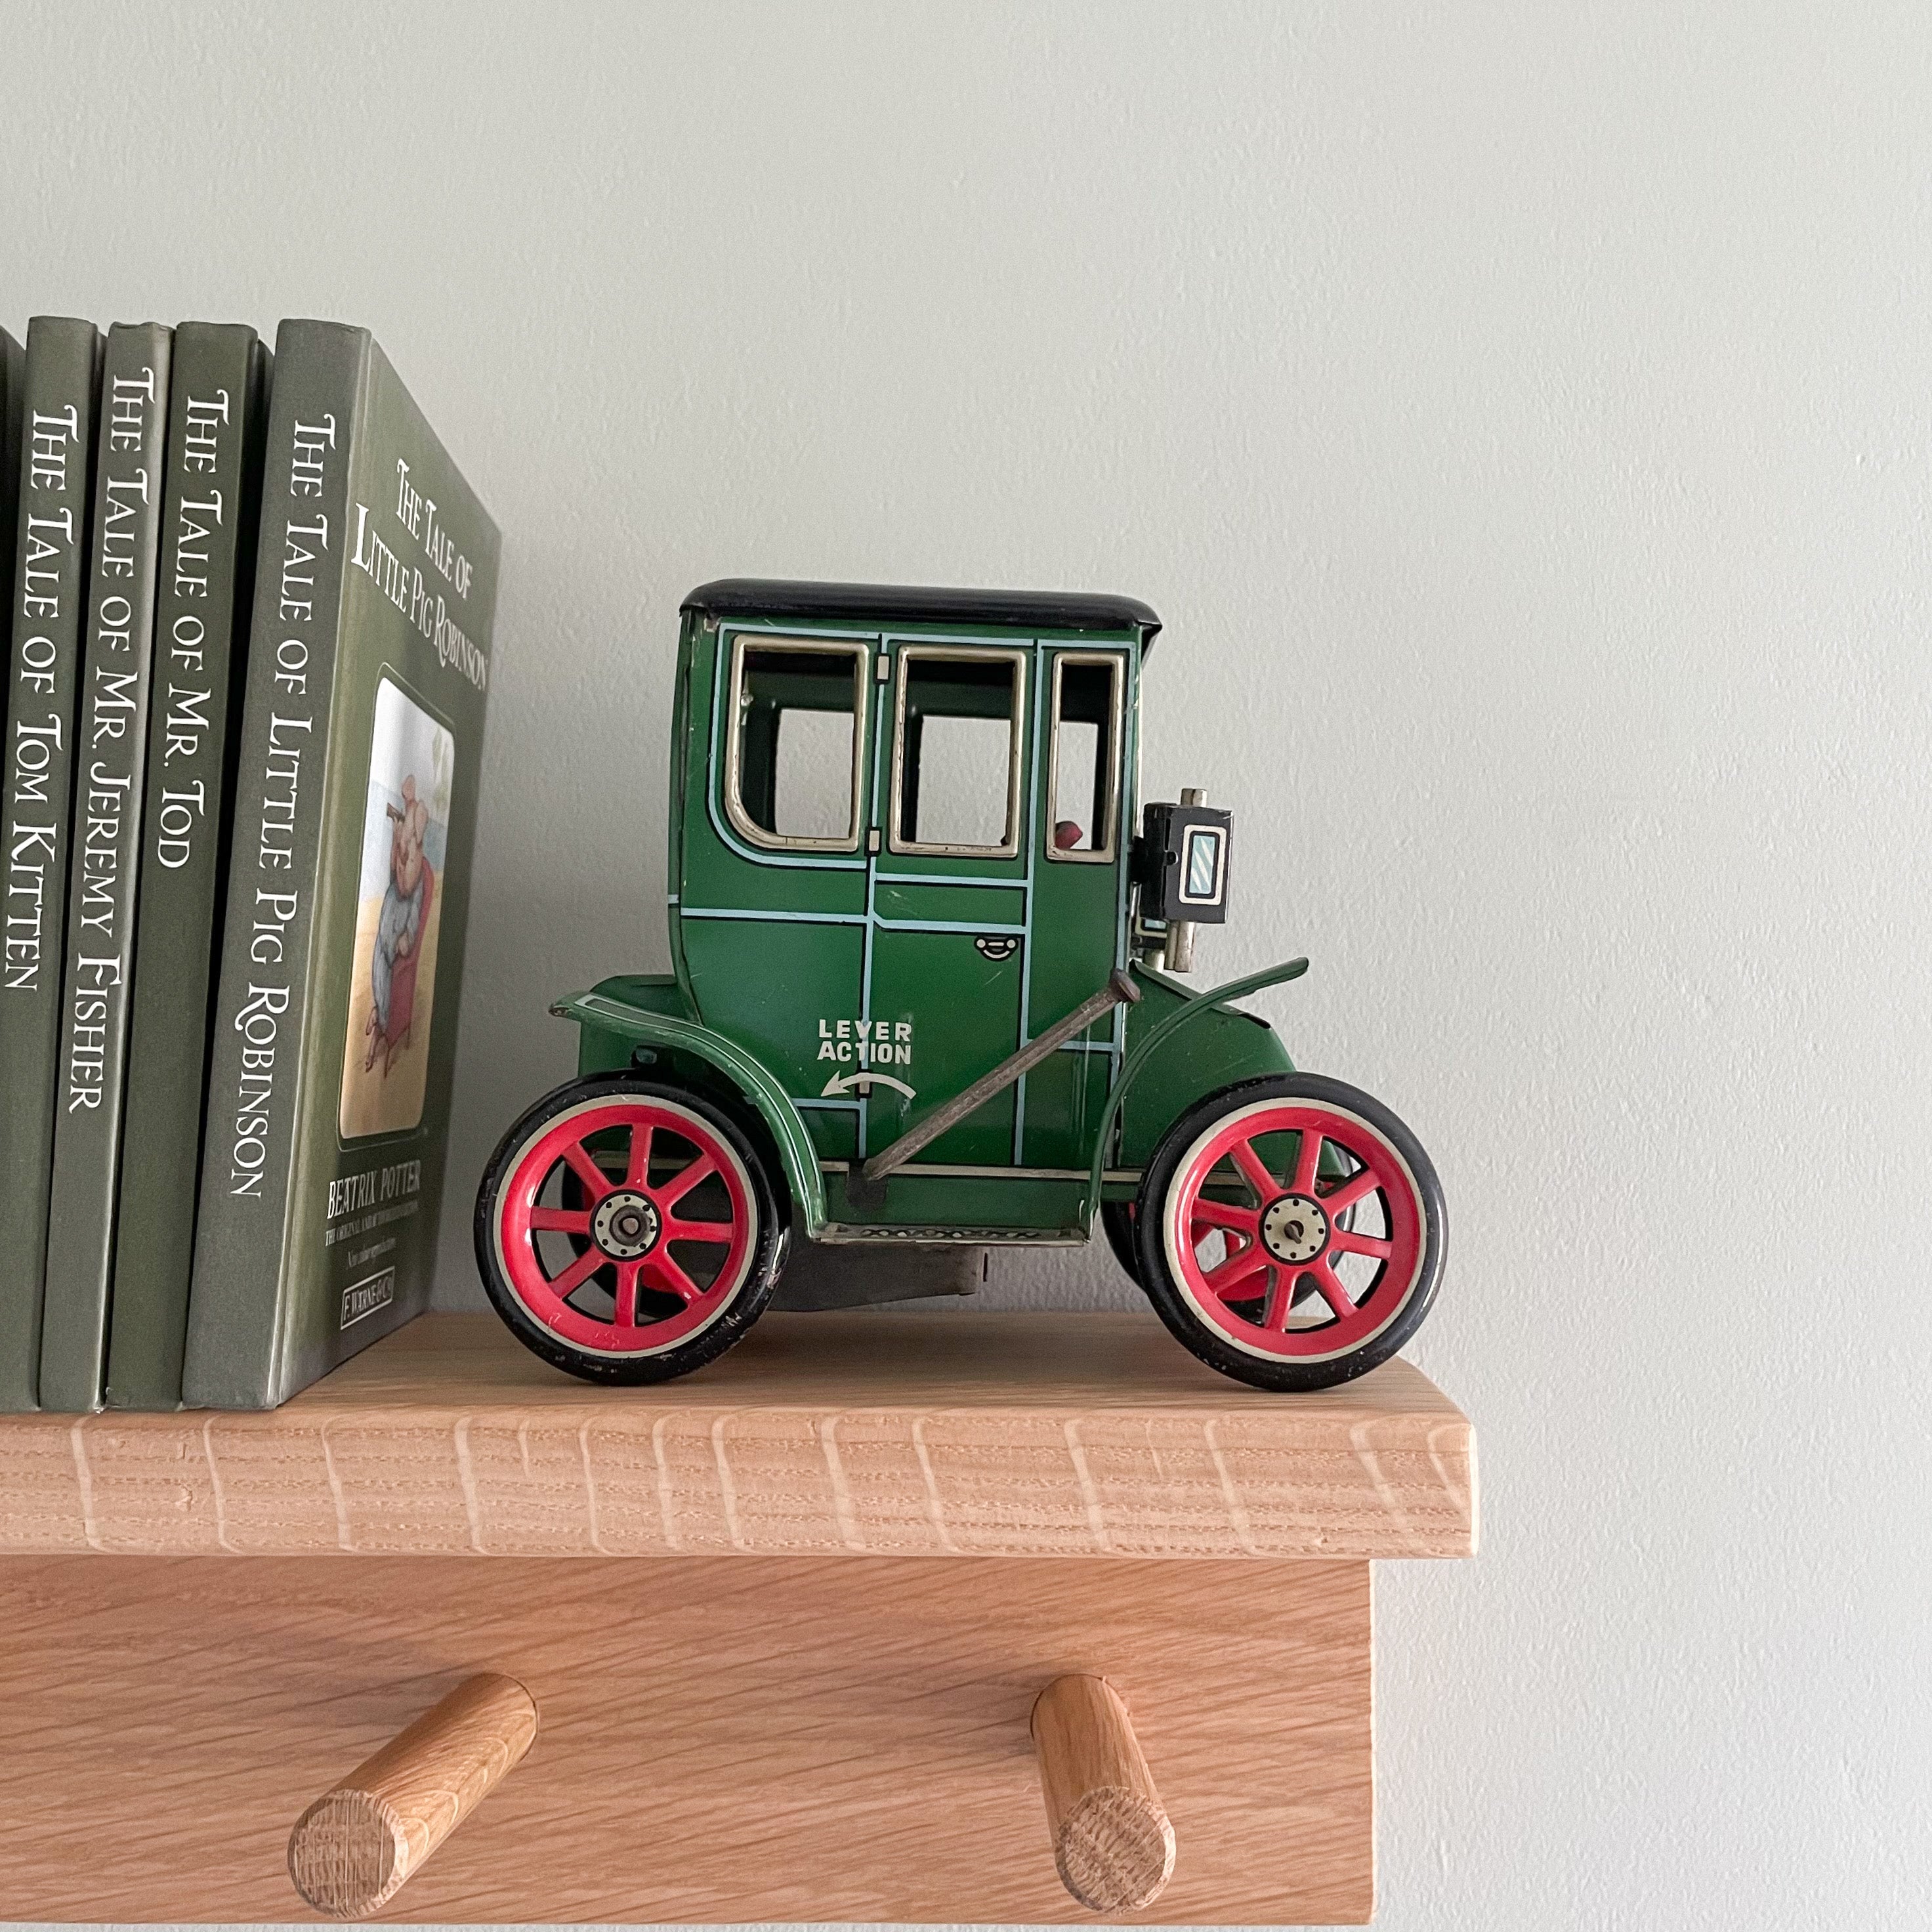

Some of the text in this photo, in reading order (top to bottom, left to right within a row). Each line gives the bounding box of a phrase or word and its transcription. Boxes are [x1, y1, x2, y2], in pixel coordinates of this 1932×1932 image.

[350, 503, 488, 691] LITTLE PIG ROBINSON
[396, 458, 472, 599] THE TALE OF
[5, 404, 79, 991] THE TALE OF TOM KITTEN
[158, 389, 229, 868] THE TALE OF MR. TOD
[69, 367, 155, 1114] THE TALE OF MR. JEREMY FISHER
[230, 413, 335, 1198] THE TALE OF LITTLE PIG ROBINSON
[817, 1041, 911, 1064] ACTION
[819, 1019, 912, 1042] LEVER
[327, 1160, 421, 1219] BEATRIX POTTER
